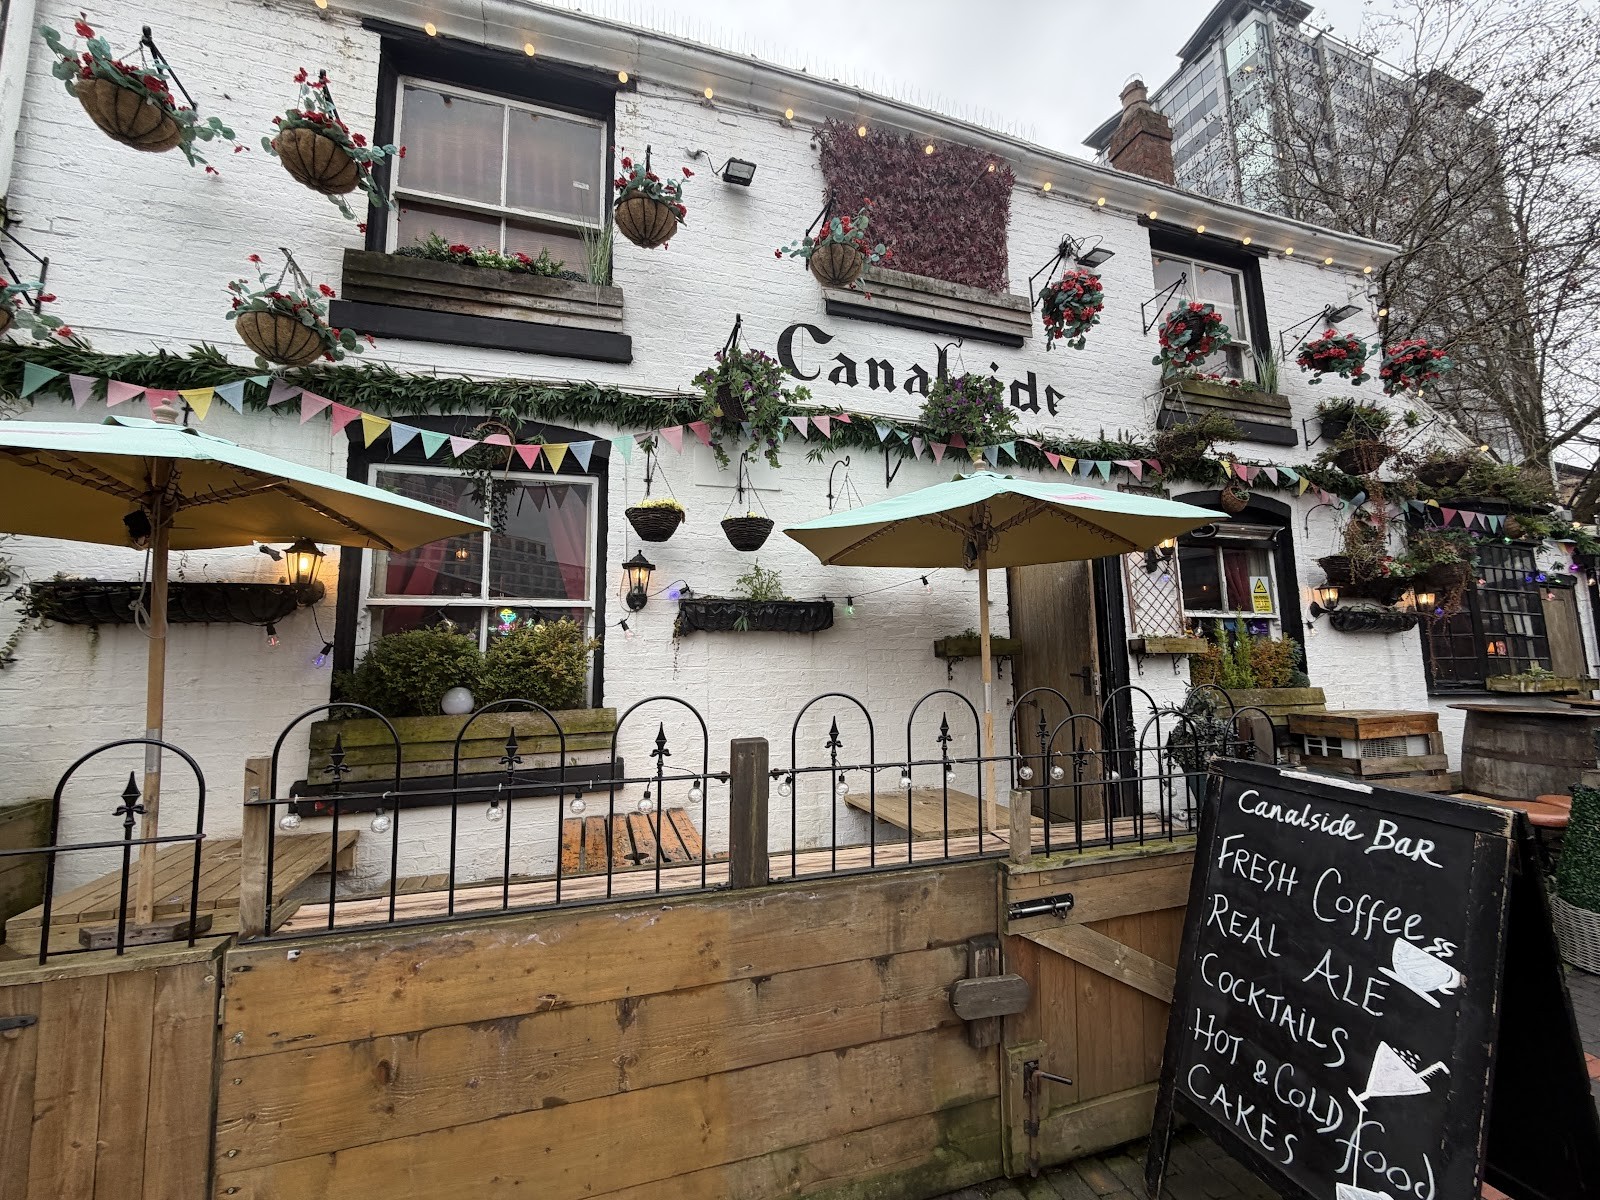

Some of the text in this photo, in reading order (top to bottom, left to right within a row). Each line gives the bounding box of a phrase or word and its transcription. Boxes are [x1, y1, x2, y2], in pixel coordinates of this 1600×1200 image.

[776, 322, 1066, 417] Canalide
[1237, 789, 1365, 842] Canalside
[1217, 833, 1424, 941] FRESH Coffee
[1206, 893, 1390, 1018] REAL ALE
[1187, 1064, 1300, 1166] CAKES
[1193, 1007, 1436, 1200] HOT & COLD food
